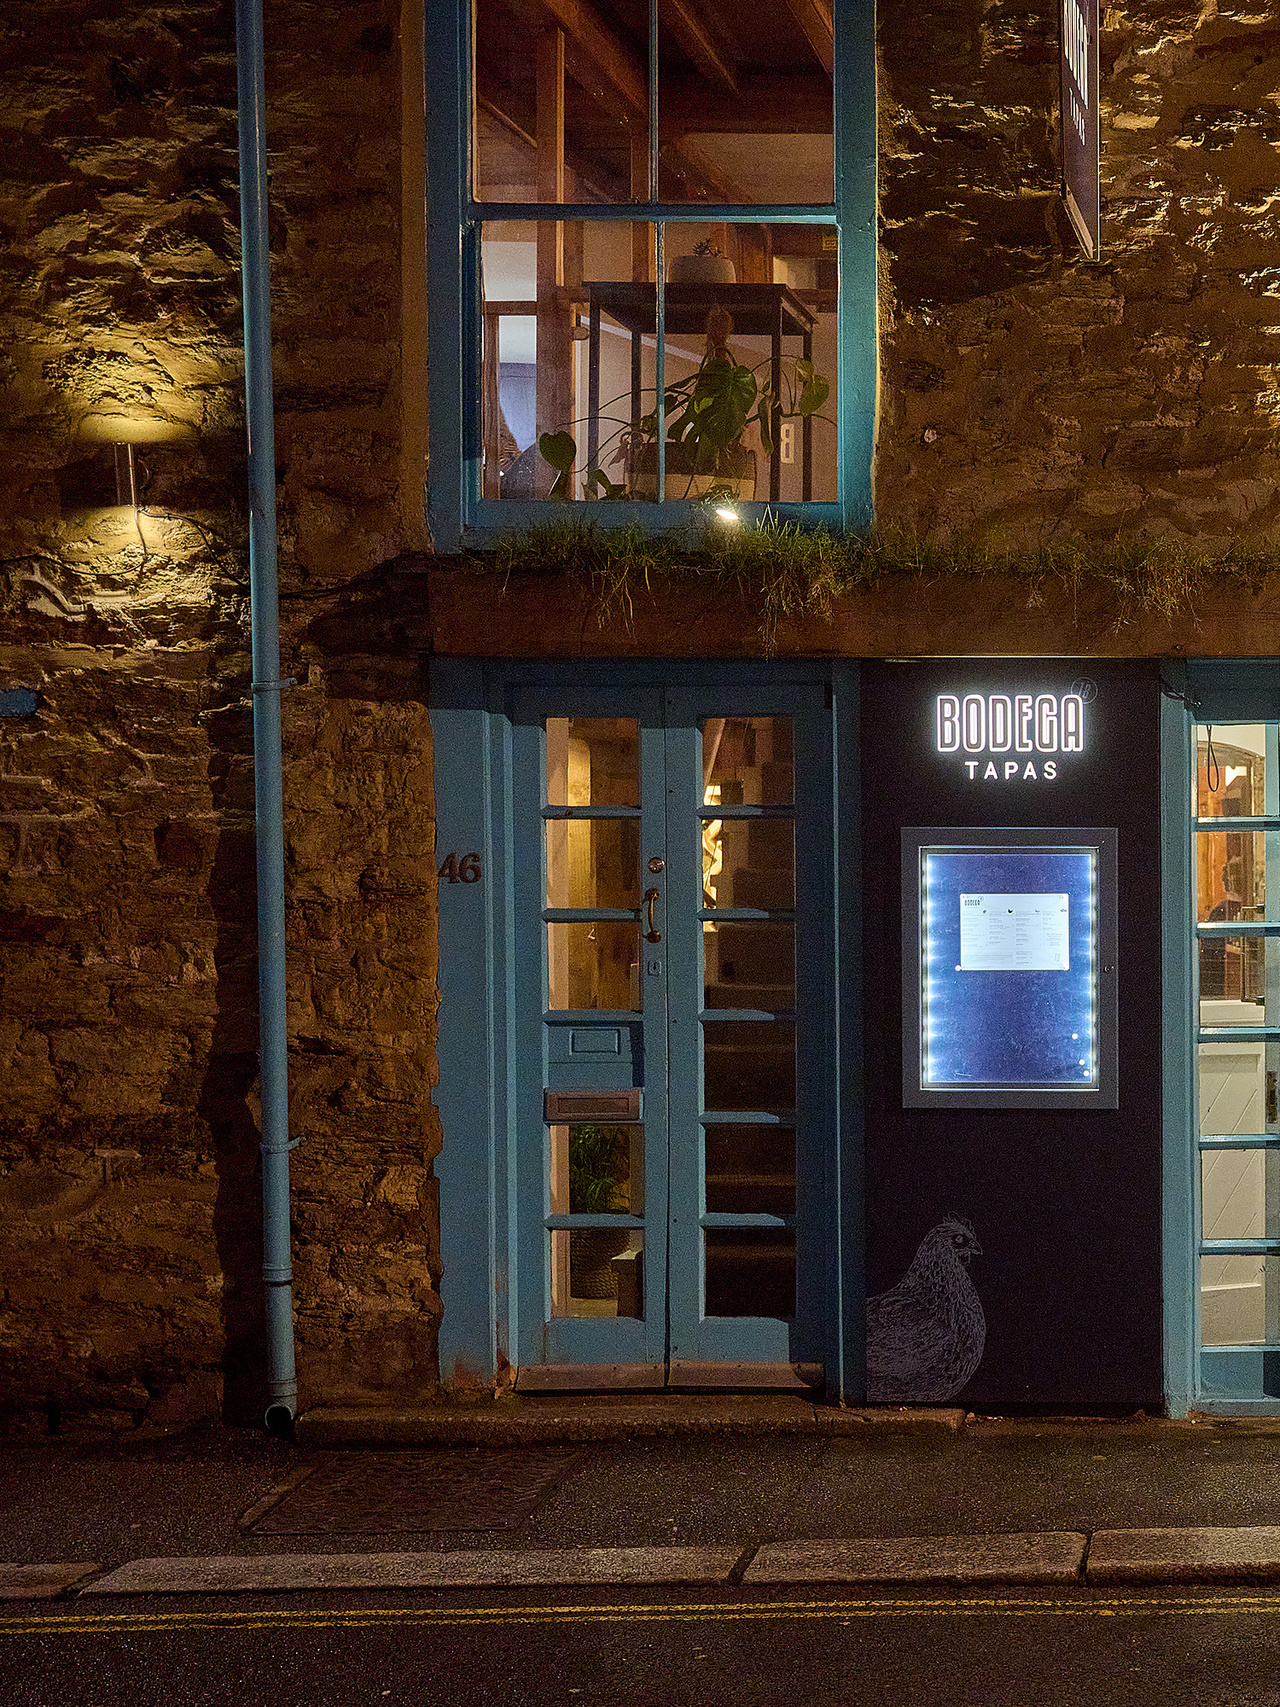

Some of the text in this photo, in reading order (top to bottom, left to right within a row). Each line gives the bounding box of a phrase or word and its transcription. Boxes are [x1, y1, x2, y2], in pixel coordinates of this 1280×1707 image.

[937, 694, 1084, 753] BODEGA
[964, 760, 1058, 780] TAPAS
[438, 852, 482, 884] 46
